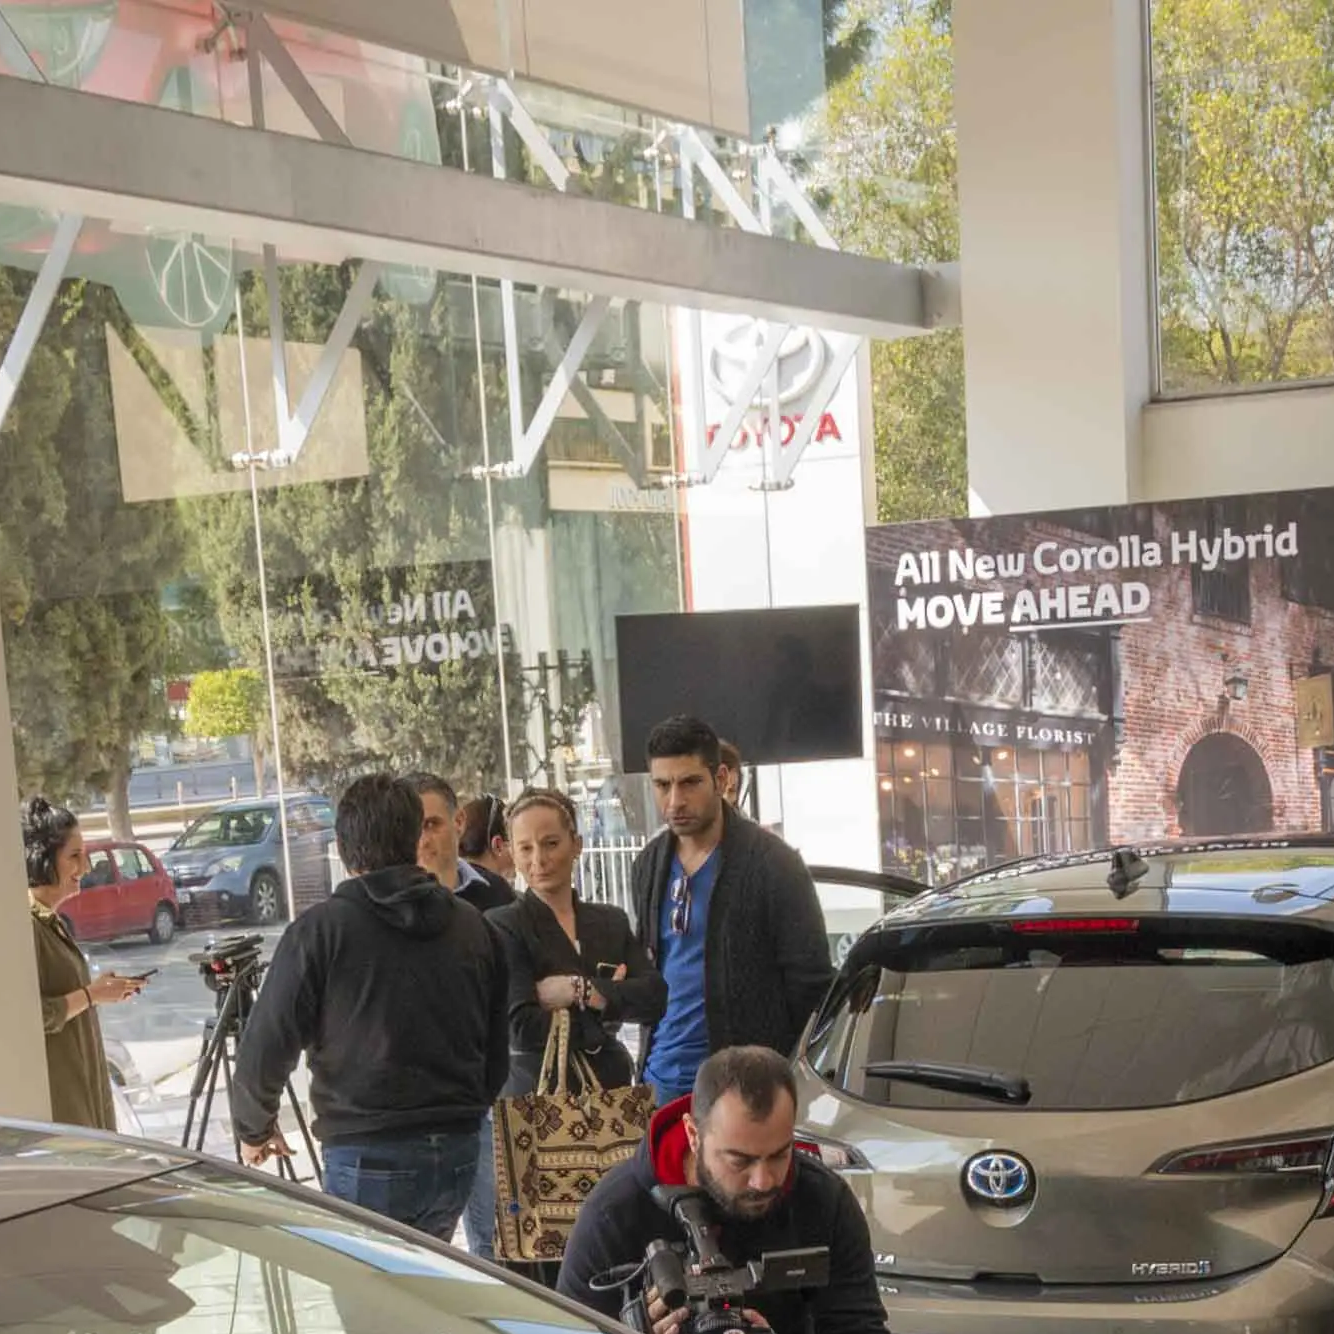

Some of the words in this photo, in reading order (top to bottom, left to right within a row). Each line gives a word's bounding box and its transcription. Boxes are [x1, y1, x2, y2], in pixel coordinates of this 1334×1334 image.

[895, 550, 941, 586] All
[948, 549, 1025, 581] New
[1033, 534, 1163, 576] Corolla
[1171, 522, 1299, 570] Hybrid
[896, 591, 1006, 631] MOVE
[1010, 581, 1152, 624] AHEAD
[873, 711, 913, 729] THE
[921, 717, 1009, 738] VILLAGE
[1015, 725, 1096, 746] FLORIST
[1131, 1262, 1199, 1276] HYBRID
